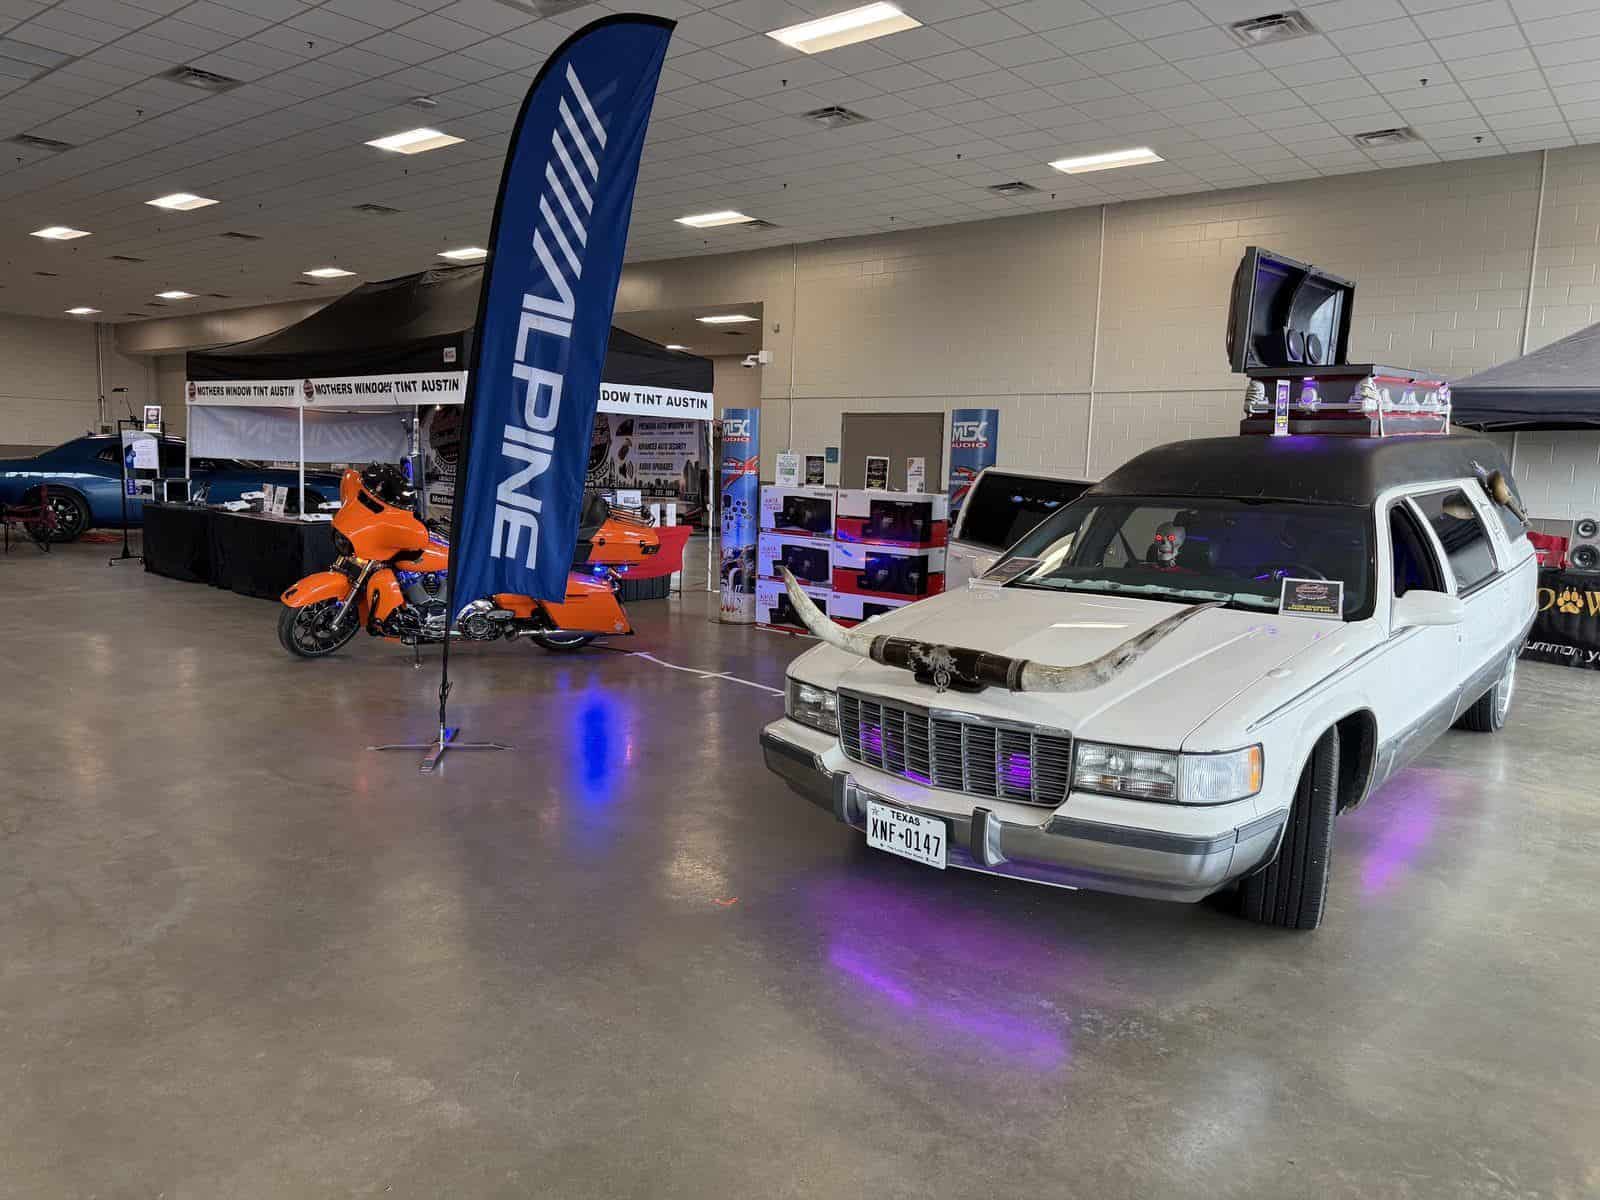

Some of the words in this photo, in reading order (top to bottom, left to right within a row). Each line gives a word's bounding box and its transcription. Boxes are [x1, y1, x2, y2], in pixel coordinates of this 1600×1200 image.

[197, 385, 225, 397] MOTHERS
[225, 385, 252, 397] WINDOW
[253, 385, 268, 397] TINT
[270, 385, 295, 397] AUSTIN
[315, 382, 353, 396] MOTHERS
[354, 381, 392, 394] WINDOW
[395, 380, 418, 393] TINT
[421, 378, 460, 392] AUSTIN
[490, 227, 576, 570] ALPINE
[634, 392, 663, 406] TINT
[666, 396, 708, 409] AUSTIN
[890, 810, 920, 827] TEXAS
